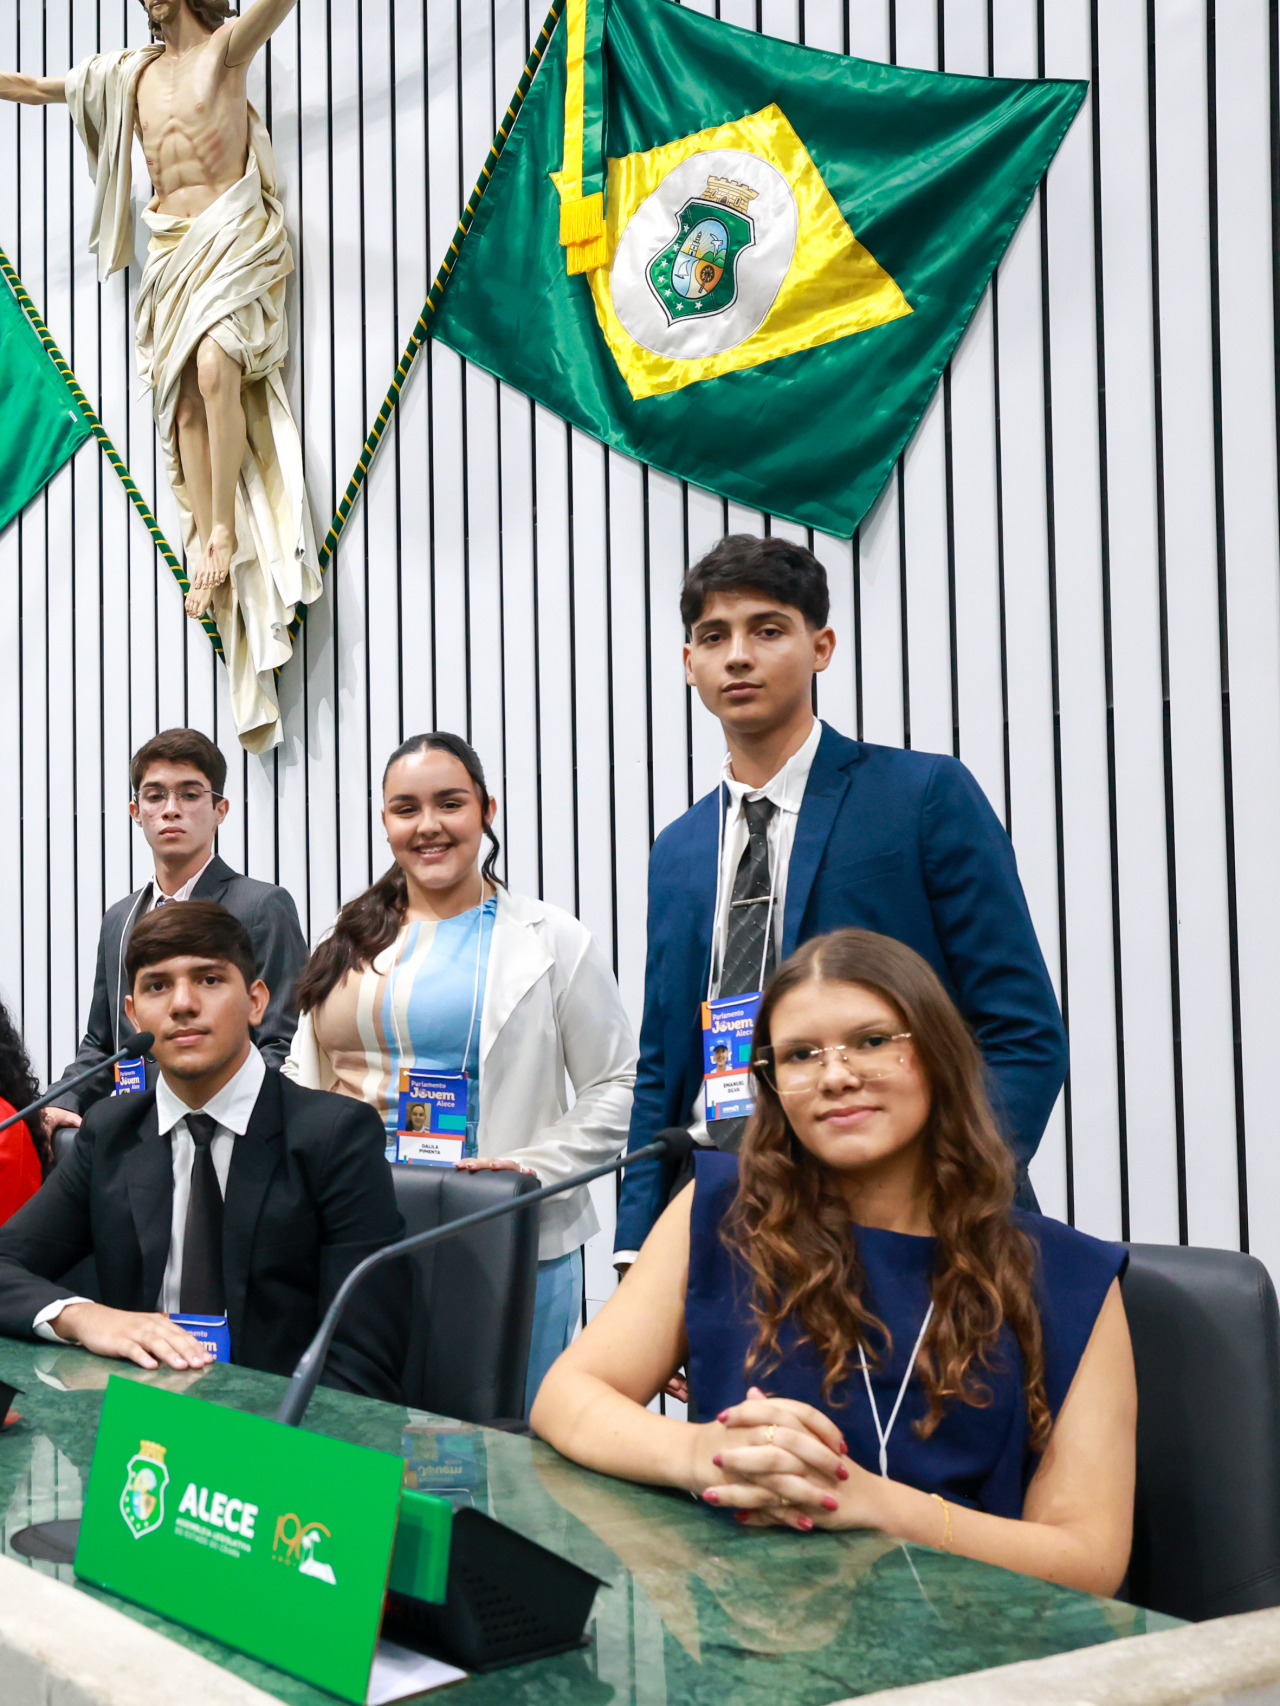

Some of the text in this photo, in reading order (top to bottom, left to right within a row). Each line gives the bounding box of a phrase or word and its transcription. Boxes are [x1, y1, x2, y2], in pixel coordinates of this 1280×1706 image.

[411, 1080, 447, 1088] Parlamento
[436, 1100, 455, 1108] Alece
[178, 1482, 259, 1540] ALECE
